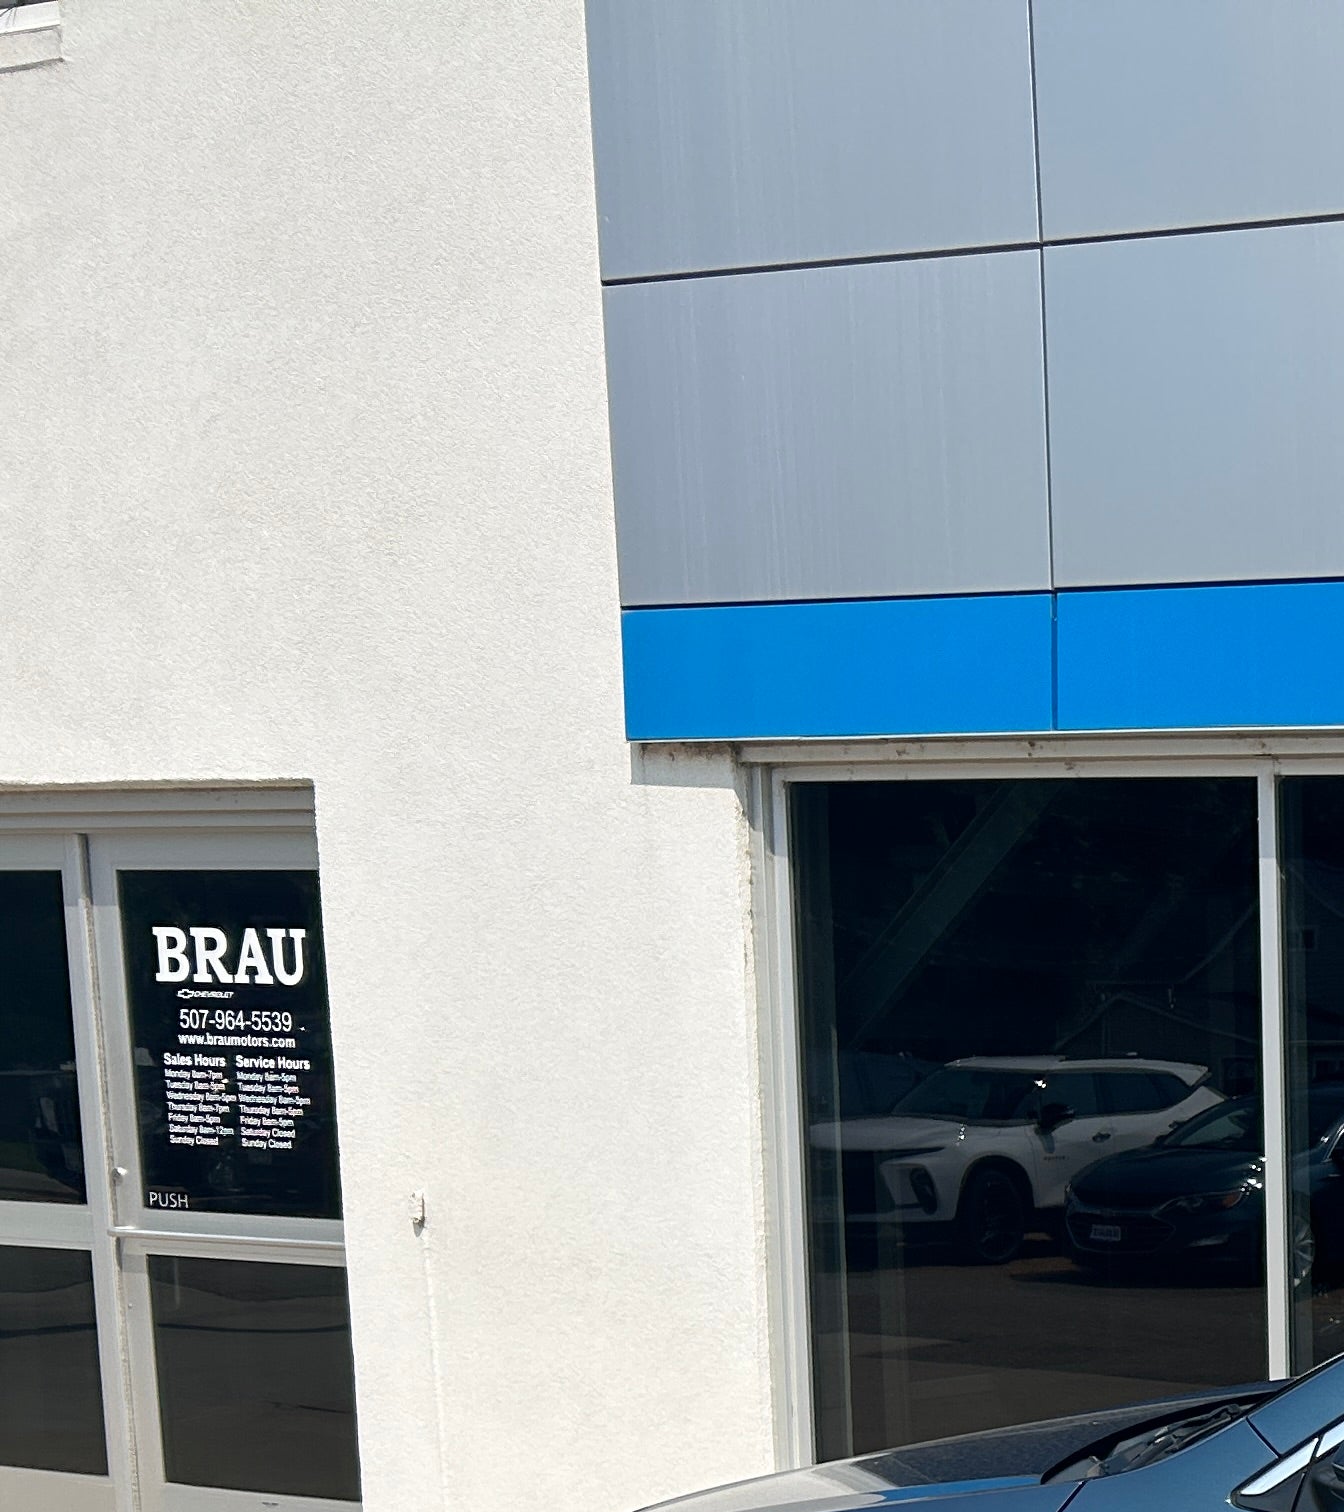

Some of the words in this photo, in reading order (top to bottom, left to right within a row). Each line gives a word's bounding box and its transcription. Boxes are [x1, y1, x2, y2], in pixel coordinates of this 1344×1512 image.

[152, 926, 306, 986] BRAU
[179, 1008, 292, 1032] 507-964-5539
[177, 1033, 296, 1048] www.braumotors.com
[163, 1052, 193, 1066] Sales
[194, 1053, 227, 1067] Hours
[235, 1054, 275, 1069] Service
[277, 1056, 311, 1070] Hours
[164, 1068, 190, 1080] Monday
[236, 1071, 263, 1082] Monday
[168, 1112, 188, 1124] Friday
[240, 1116, 261, 1127] Friday
[149, 1191, 189, 1208] PUSH
